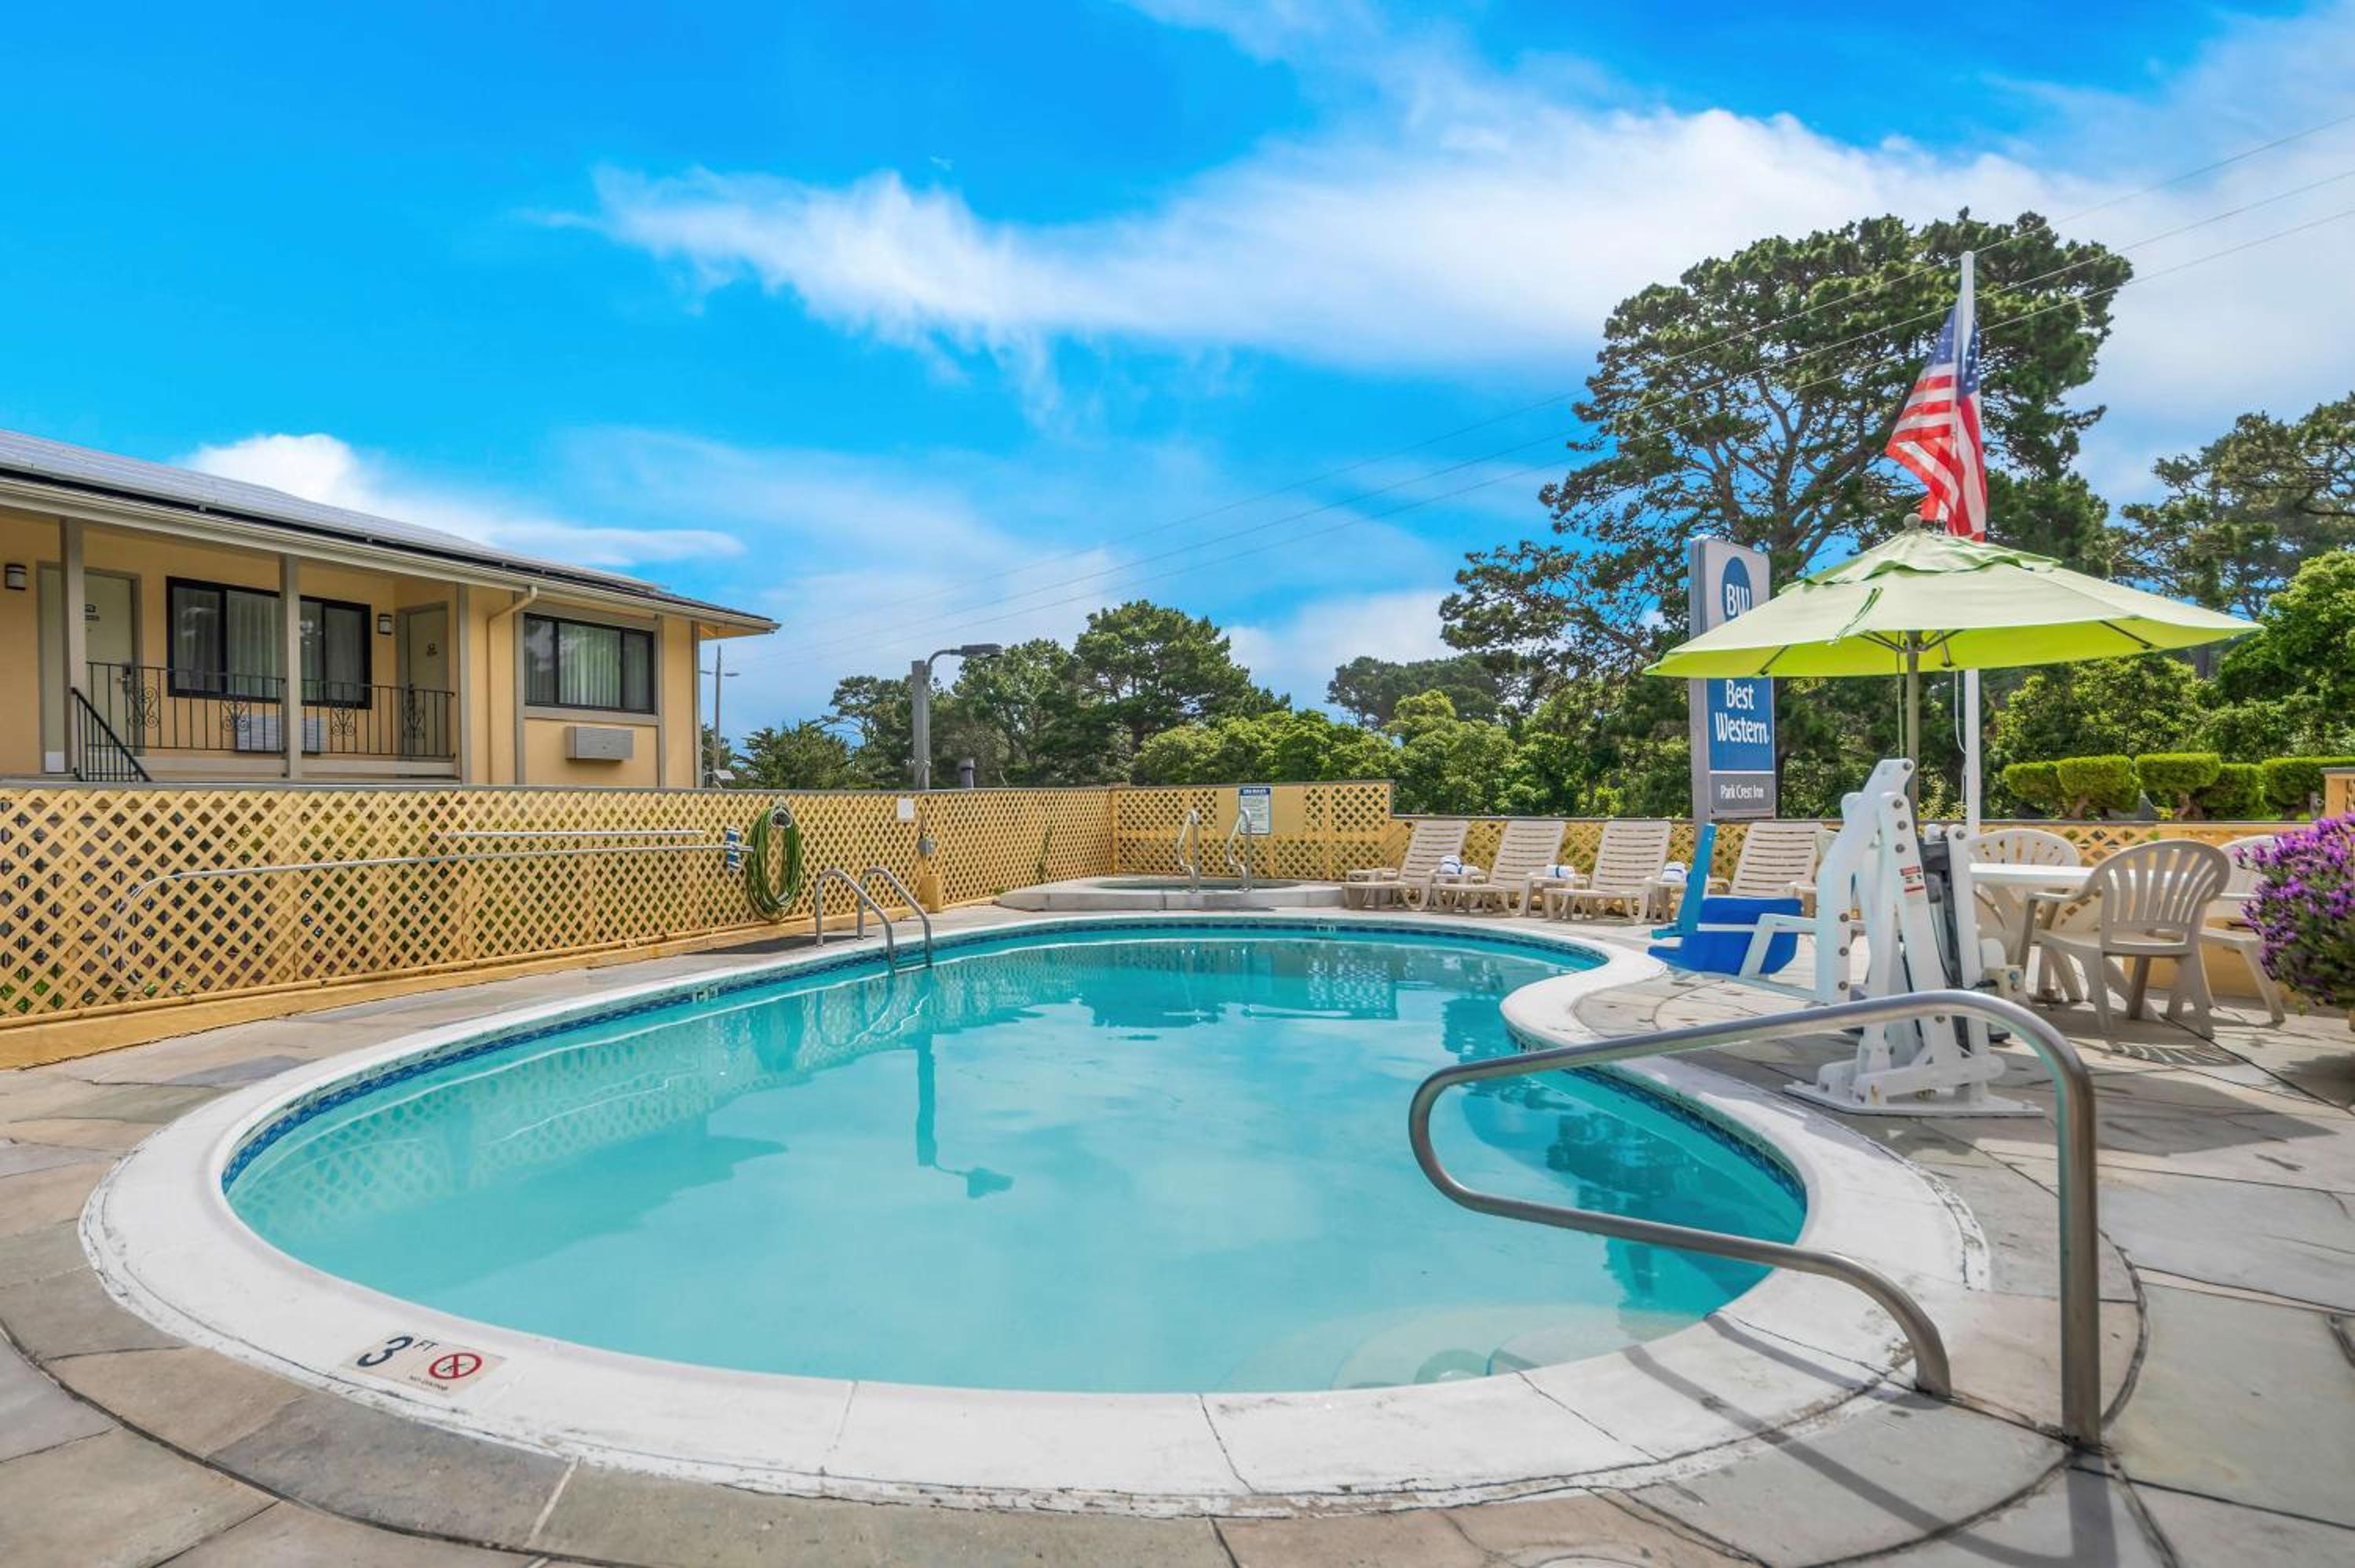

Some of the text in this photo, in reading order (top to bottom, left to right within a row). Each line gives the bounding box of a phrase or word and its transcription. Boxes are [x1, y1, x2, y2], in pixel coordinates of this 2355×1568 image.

[1726, 583, 1750, 617] BW
[1726, 679, 1754, 709] Best
[1715, 712, 1769, 744] Western
[1720, 784, 1764, 799] Park Crest Inn
[356, 1336, 439, 1367] 3 FT
